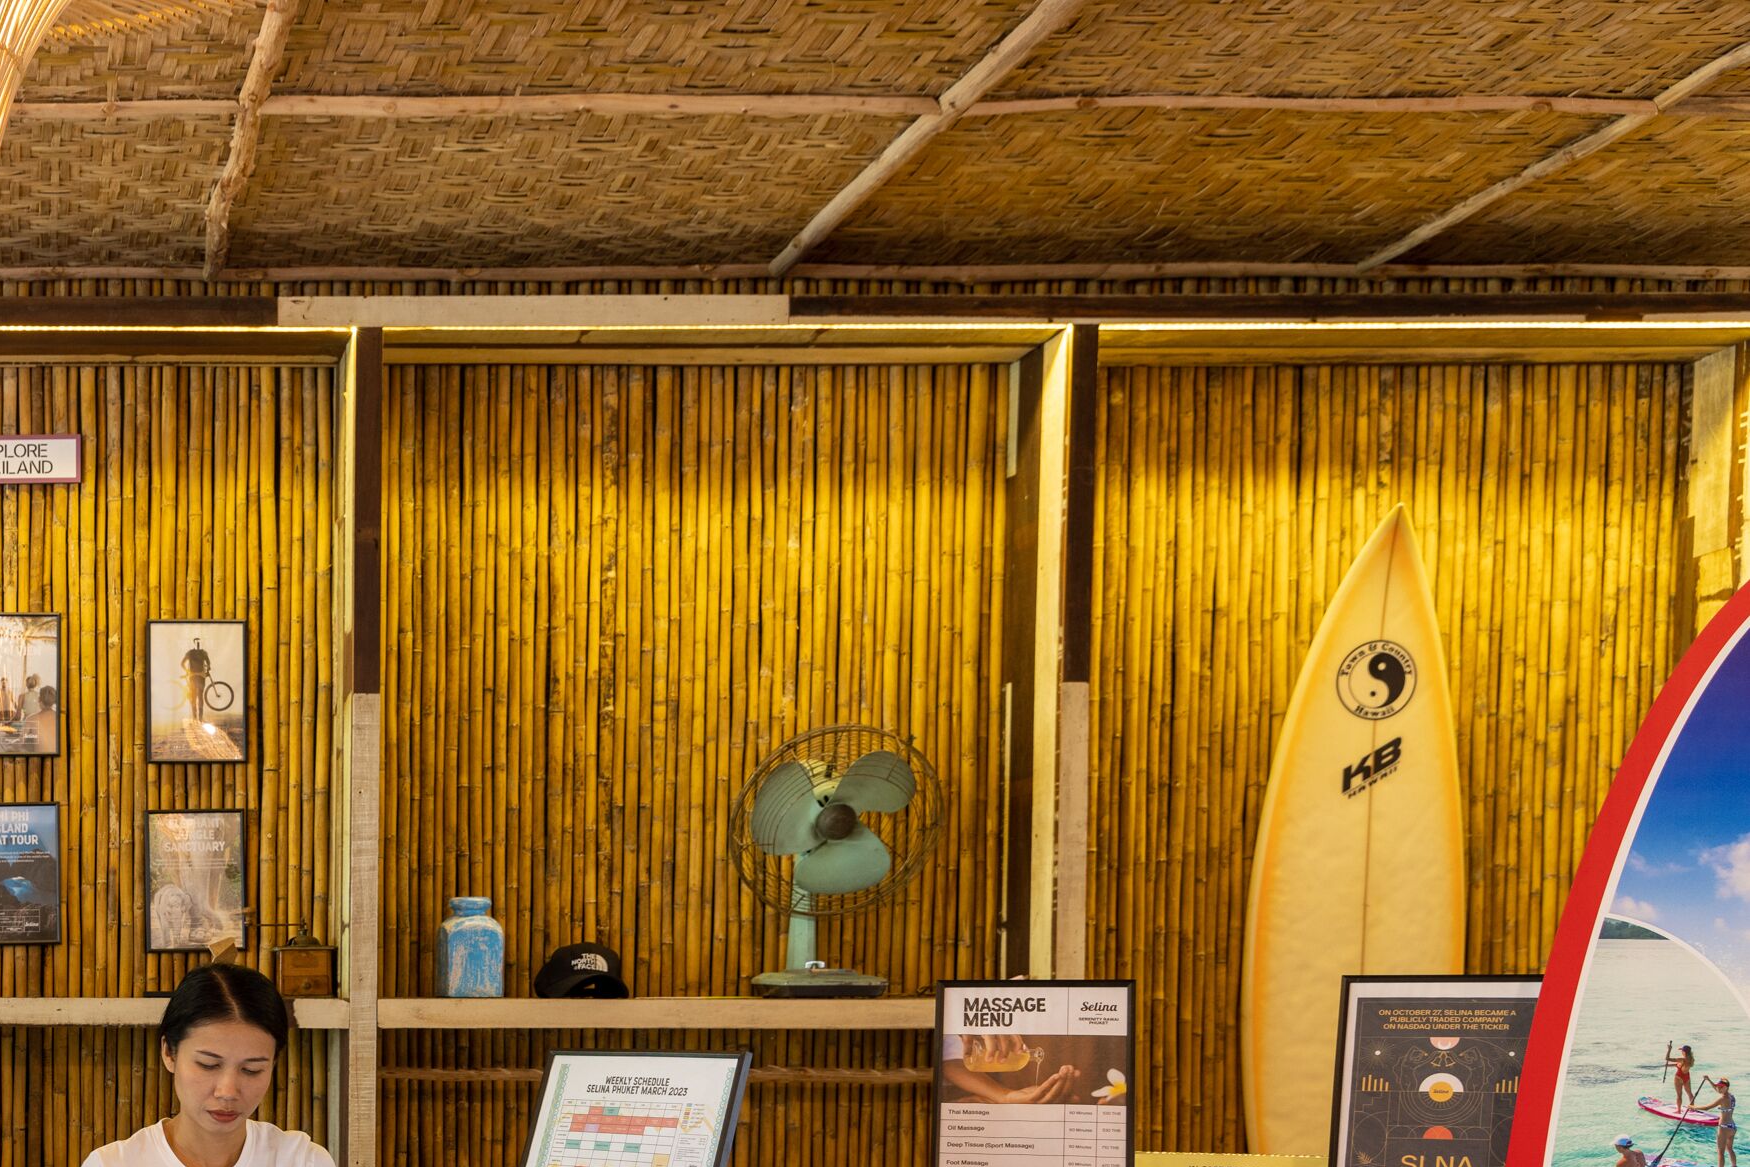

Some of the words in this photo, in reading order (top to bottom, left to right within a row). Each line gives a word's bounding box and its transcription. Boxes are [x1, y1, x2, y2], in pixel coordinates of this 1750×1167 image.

[1341, 736, 1402, 793] KB
[11, 835, 39, 846] TOUR
[963, 997, 1046, 1012] MASSAGE
[1080, 1001, 1118, 1012] Selina
[963, 1012, 1013, 1027] MENU
[605, 1076, 632, 1085] WEEKLY
[633, 1077, 670, 1087] SCHEDULE
[586, 1085, 610, 1094] SELINA
[611, 1086, 640, 1095] PHUKET
[640, 1087, 668, 1096] MARCH
[668, 1088, 688, 1097] 2023
[1005, 1142, 1035, 1150] Massage)
